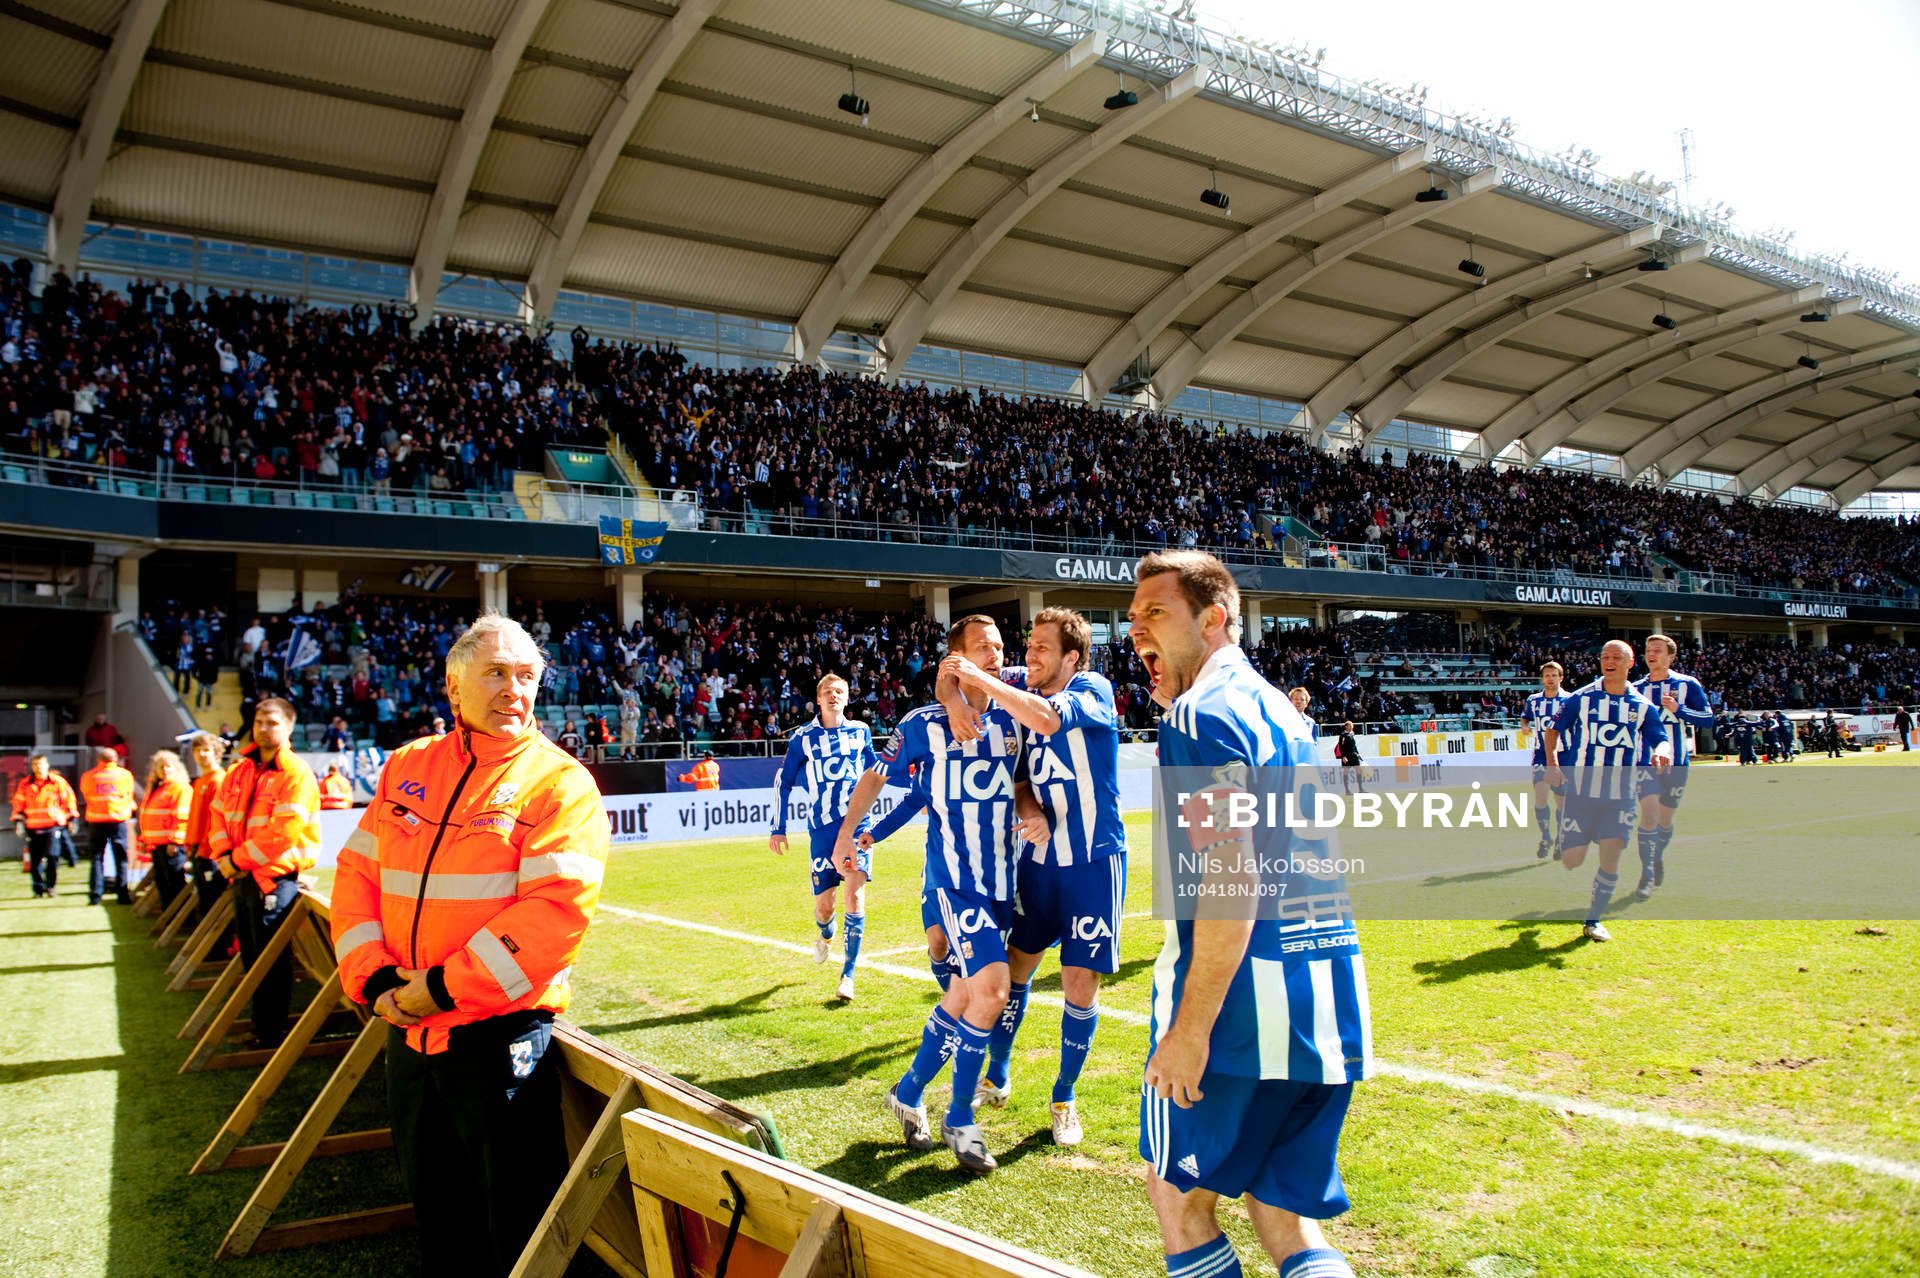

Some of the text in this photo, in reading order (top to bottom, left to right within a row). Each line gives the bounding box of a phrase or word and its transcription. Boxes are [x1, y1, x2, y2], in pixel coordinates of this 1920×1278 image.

[1055, 558, 1133, 581] GAMLA
[1515, 585, 1612, 606] GAMLA ULLEVI
[1784, 602, 1848, 618] GAMLA ULLEVI
[1589, 722, 1635, 748] ICA
[815, 757, 858, 783] ICA
[1028, 745, 1076, 785] CA
[397, 780, 425, 802] ICA
[949, 759, 1014, 801] ICA
[679, 802, 696, 827] vi
[704, 800, 771, 831] jobbar
[1562, 818, 1582, 833] CA
[814, 857, 834, 873] CA
[952, 907, 998, 938] ICA
[1071, 915, 1113, 941] ICA
[1088, 943, 1101, 959] 7
[1281, 939, 1317, 954] SEFA
